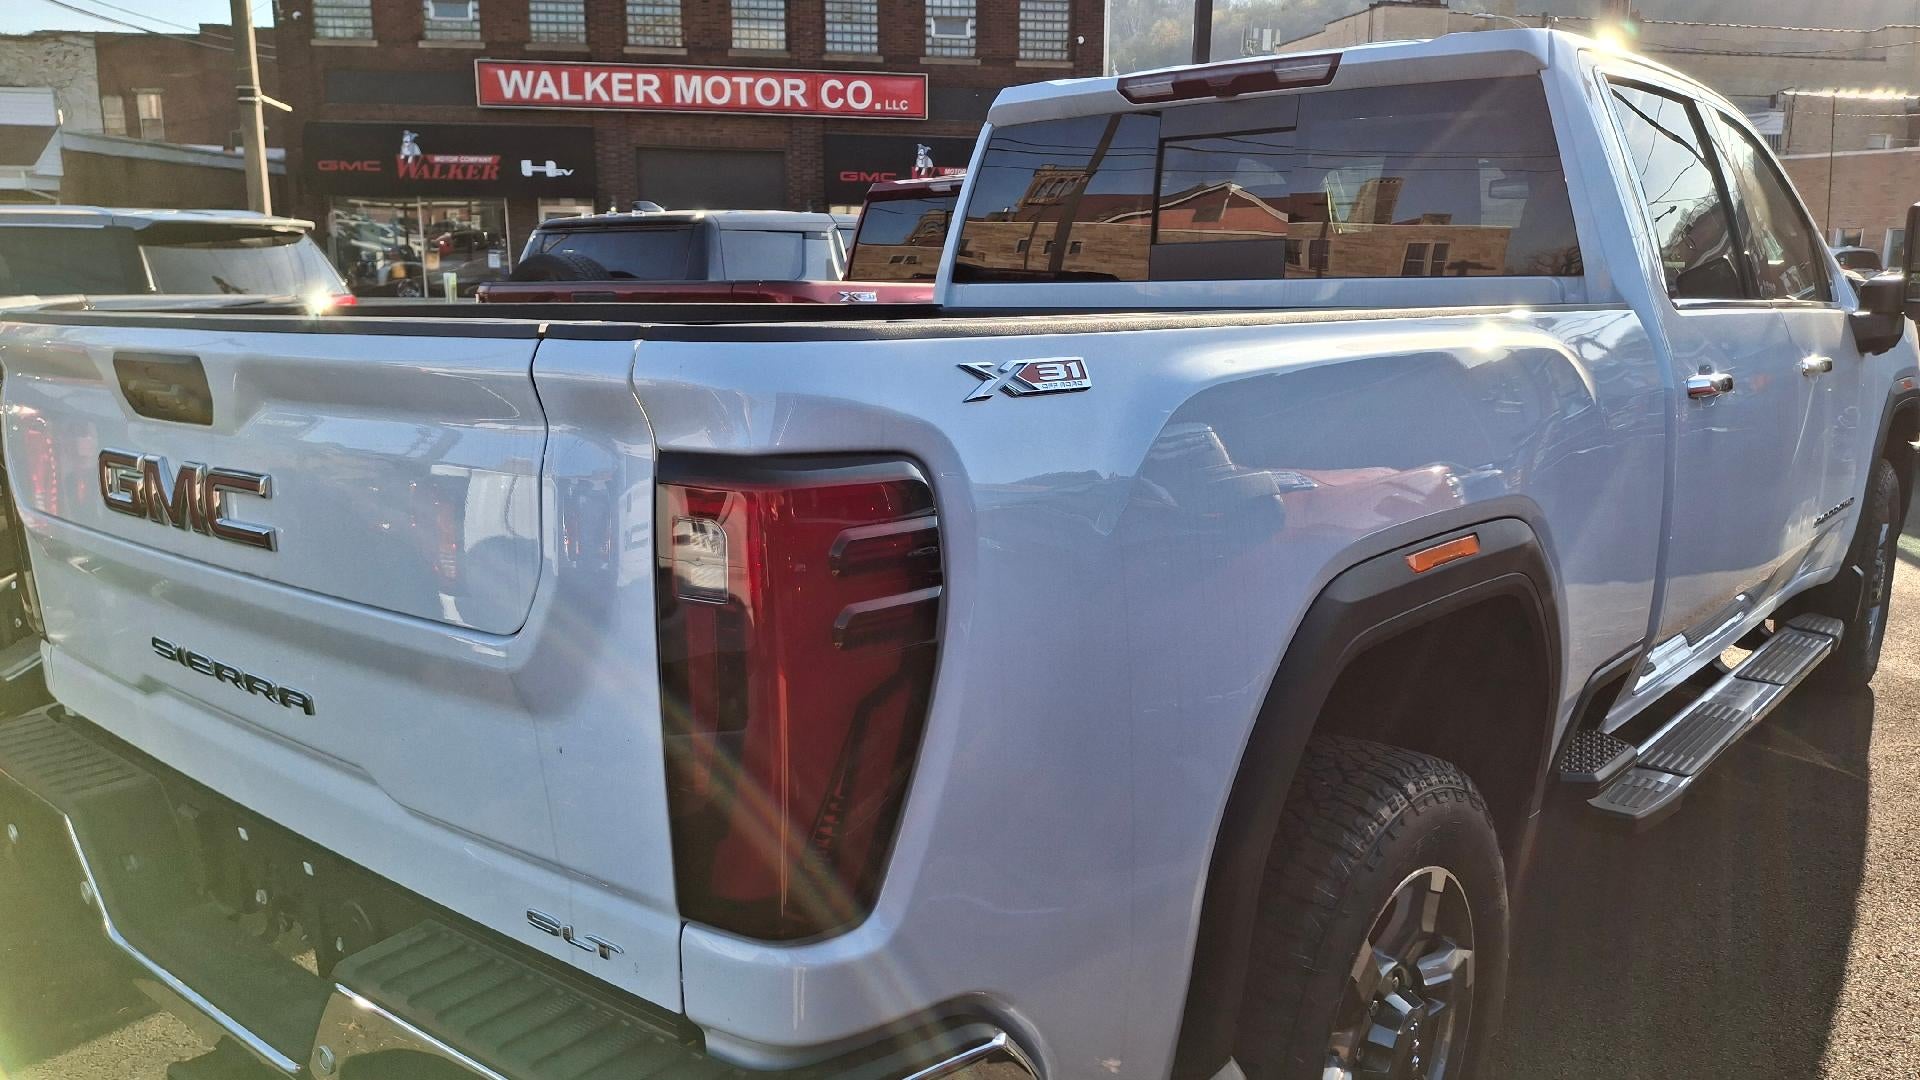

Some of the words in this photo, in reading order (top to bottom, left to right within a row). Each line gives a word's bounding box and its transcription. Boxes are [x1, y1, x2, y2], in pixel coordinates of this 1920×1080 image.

[497, 69, 662, 104] WALKER
[674, 74, 807, 107] MOTOR
[819, 79, 883, 111] CO.
[884, 100, 909, 111] LLC
[317, 160, 382, 172] GMC
[395, 154, 500, 181] WALKER
[839, 170, 897, 182] GMC
[98, 447, 278, 552] GMC
[151, 635, 316, 716] SIERRA
[526, 908, 625, 960] SLT
